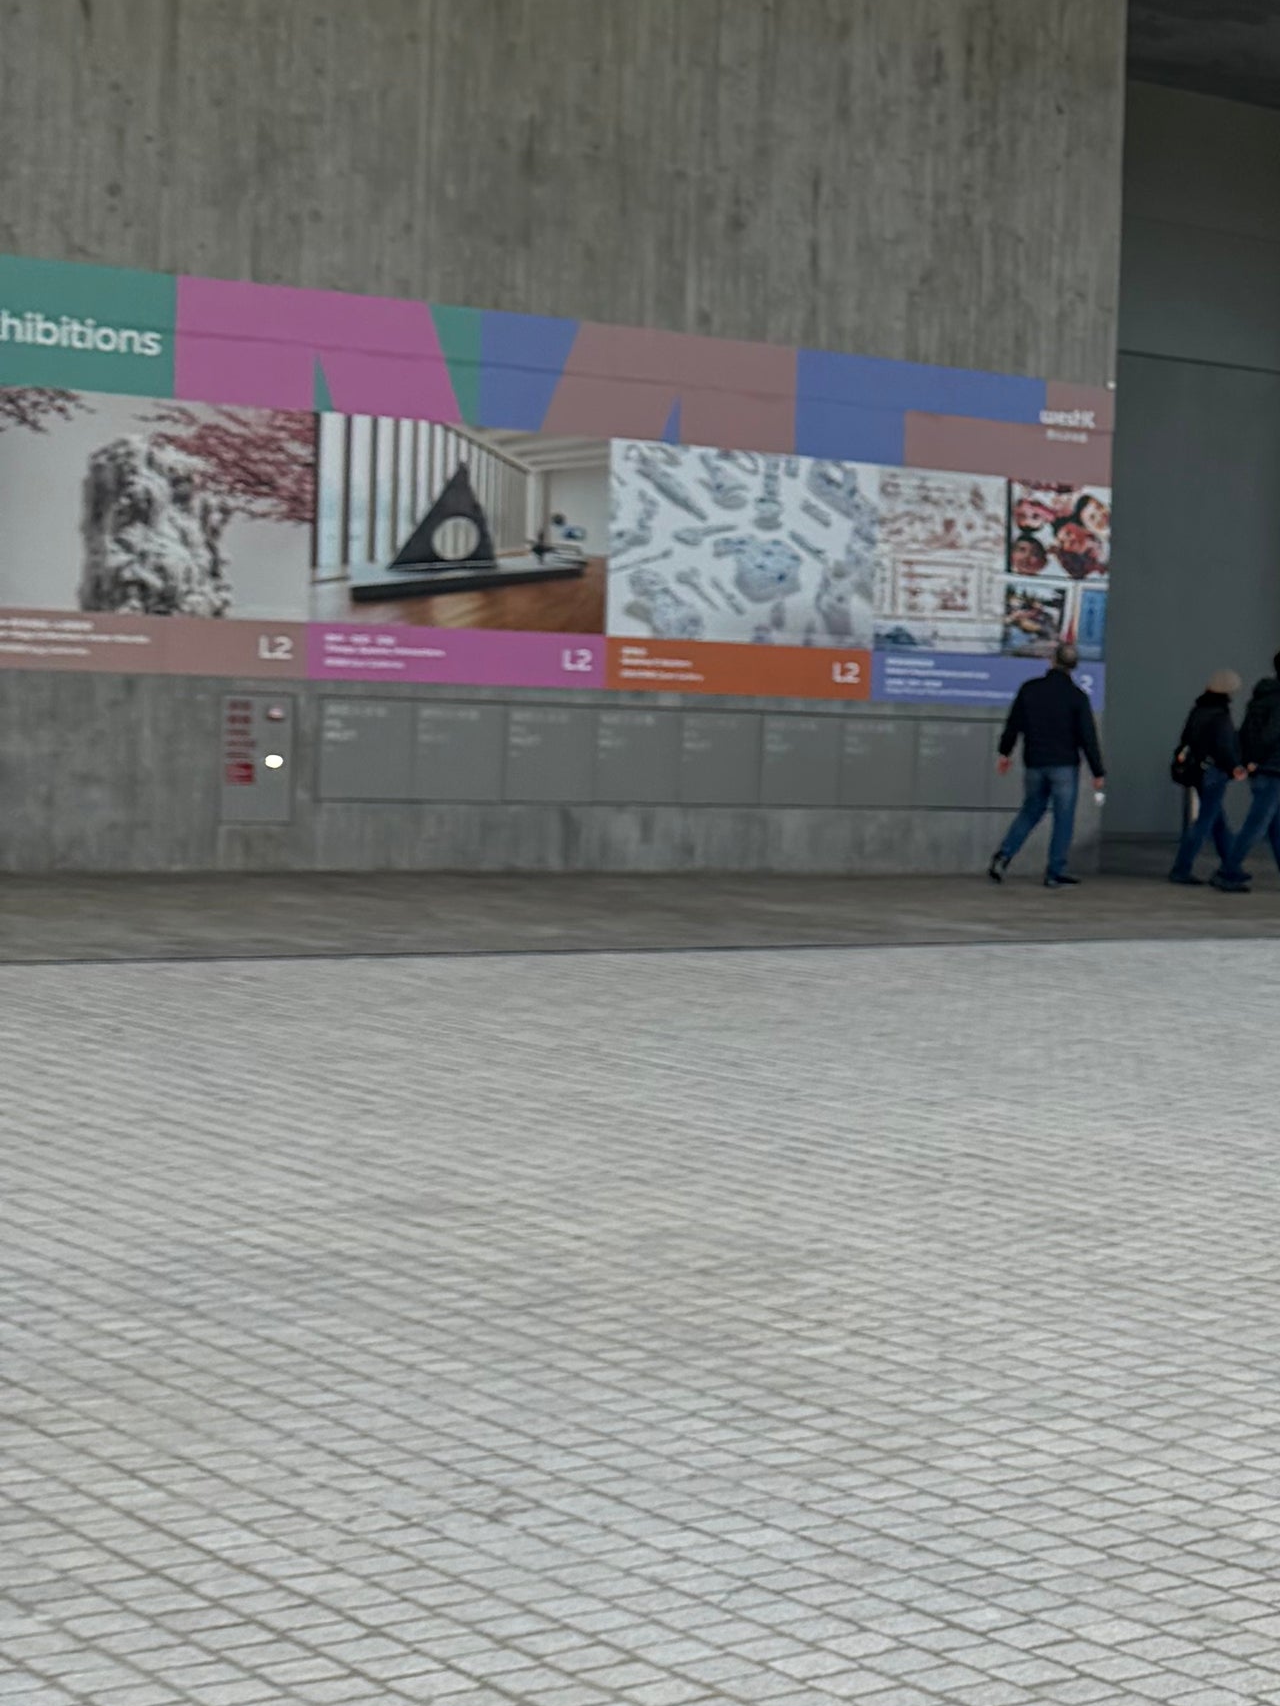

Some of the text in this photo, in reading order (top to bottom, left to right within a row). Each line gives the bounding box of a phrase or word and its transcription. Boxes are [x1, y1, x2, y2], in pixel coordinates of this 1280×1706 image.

[0, 308, 163, 357] hibitions
[257, 633, 294, 661] L2
[561, 647, 594, 673] L2
[831, 661, 861, 685] L2
